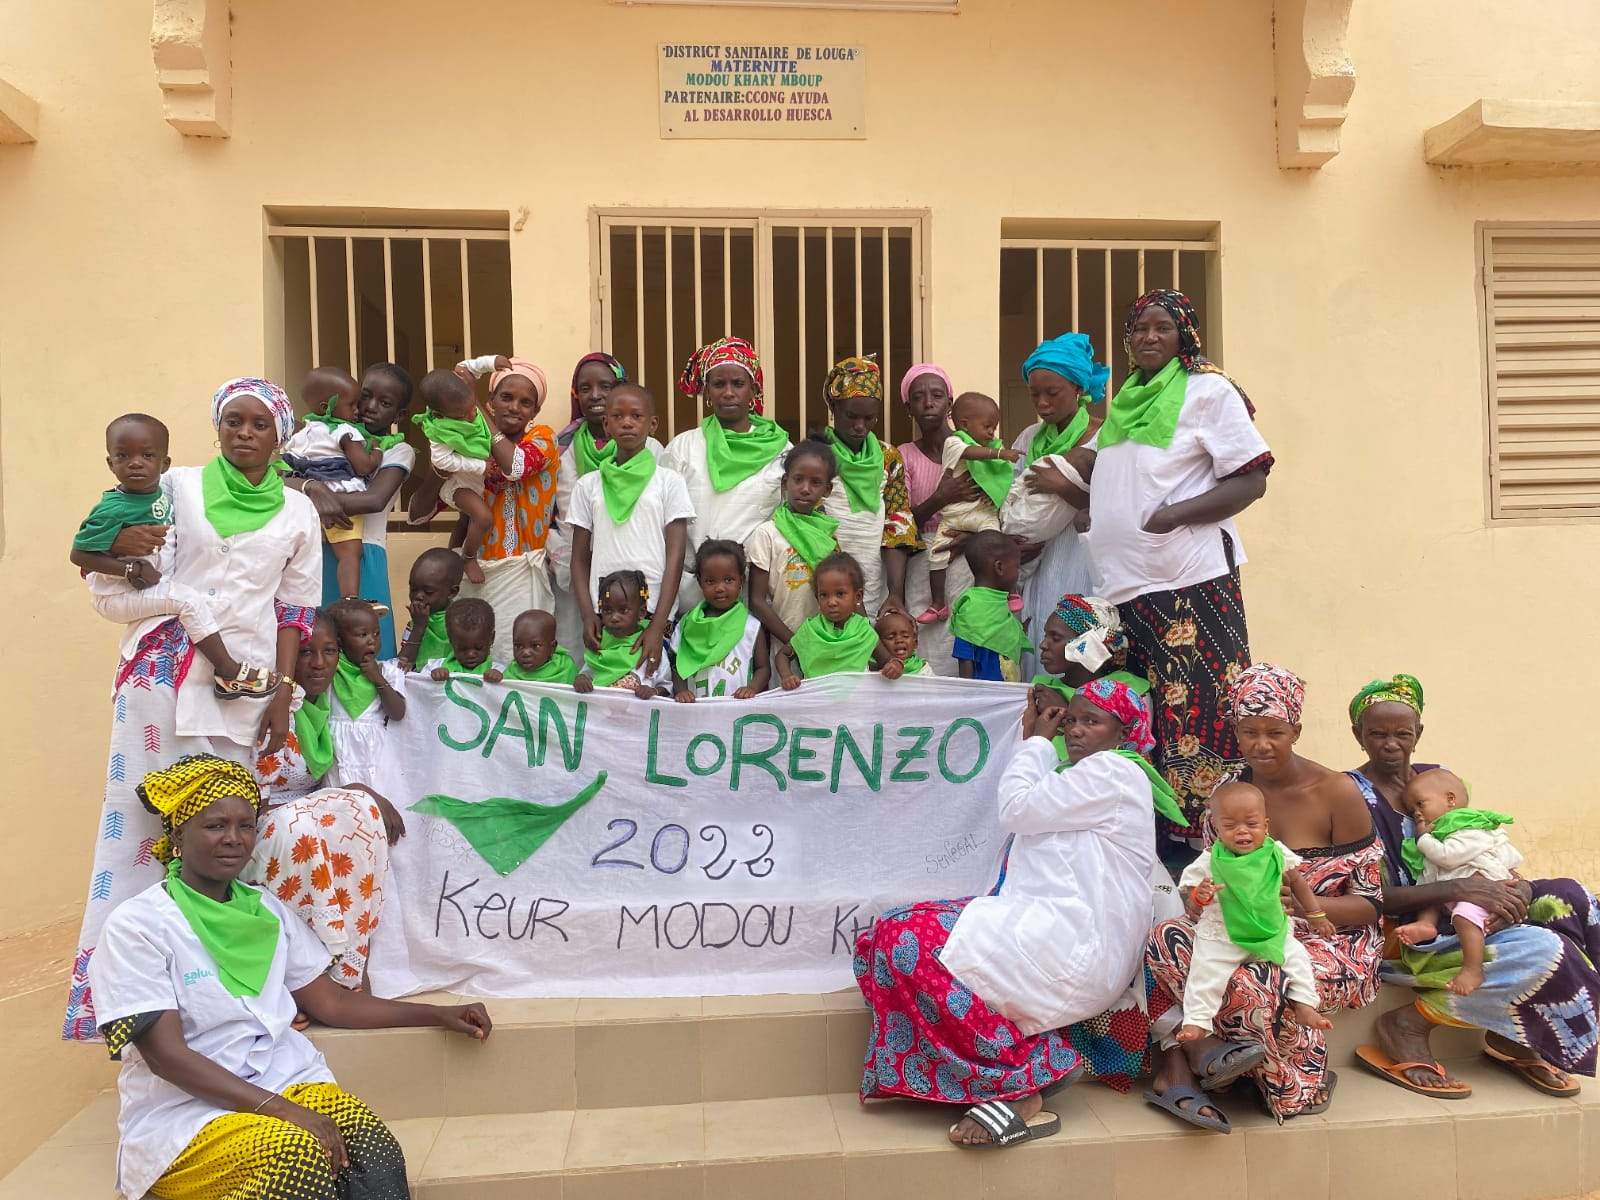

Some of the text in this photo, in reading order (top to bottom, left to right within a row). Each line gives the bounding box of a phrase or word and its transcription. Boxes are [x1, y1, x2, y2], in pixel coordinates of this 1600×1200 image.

[664, 45, 854, 60] DISTRICT SANITAIRE DE LOUGA
[710, 60, 797, 73] MATERNITE
[686, 73, 823, 87] MODOU KHARY MBOUP
[789, 91, 829, 104] AYUDA
[684, 108, 833, 122] AL DESARROLLO HUESCA
[437, 676, 588, 773] SAN
[591, 818, 775, 880] 2022
[616, 902, 794, 950] MODOU
